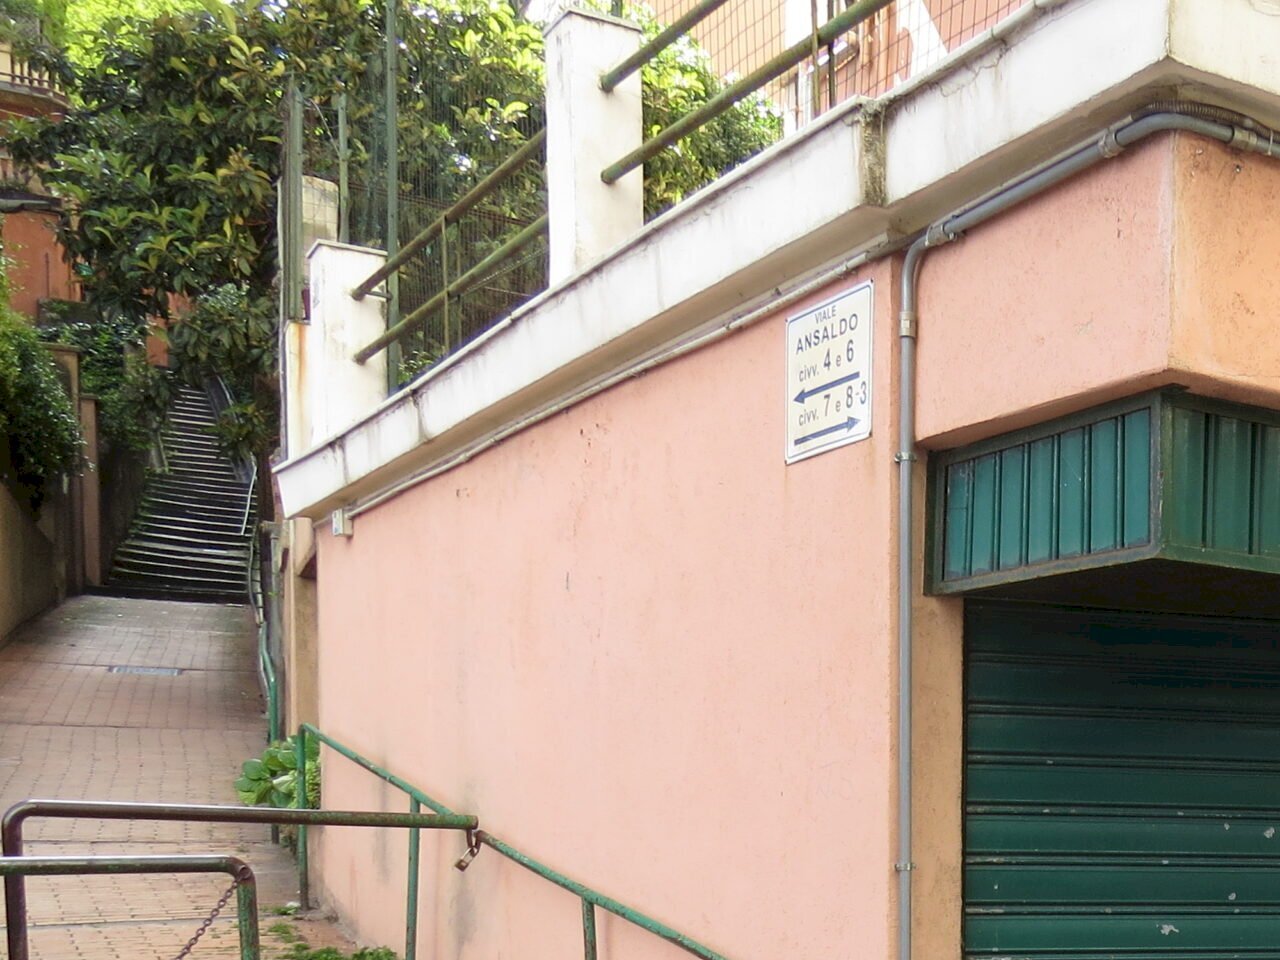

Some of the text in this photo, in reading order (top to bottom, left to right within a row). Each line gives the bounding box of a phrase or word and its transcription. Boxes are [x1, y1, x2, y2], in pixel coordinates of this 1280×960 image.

[814, 305, 837, 324] VIALE
[796, 313, 859, 355] ANSALDO
[799, 339, 854, 382] civv. 4 e 6
[799, 408, 819, 426] civv.
[823, 394, 831, 417] 7
[835, 400, 841, 413] e
